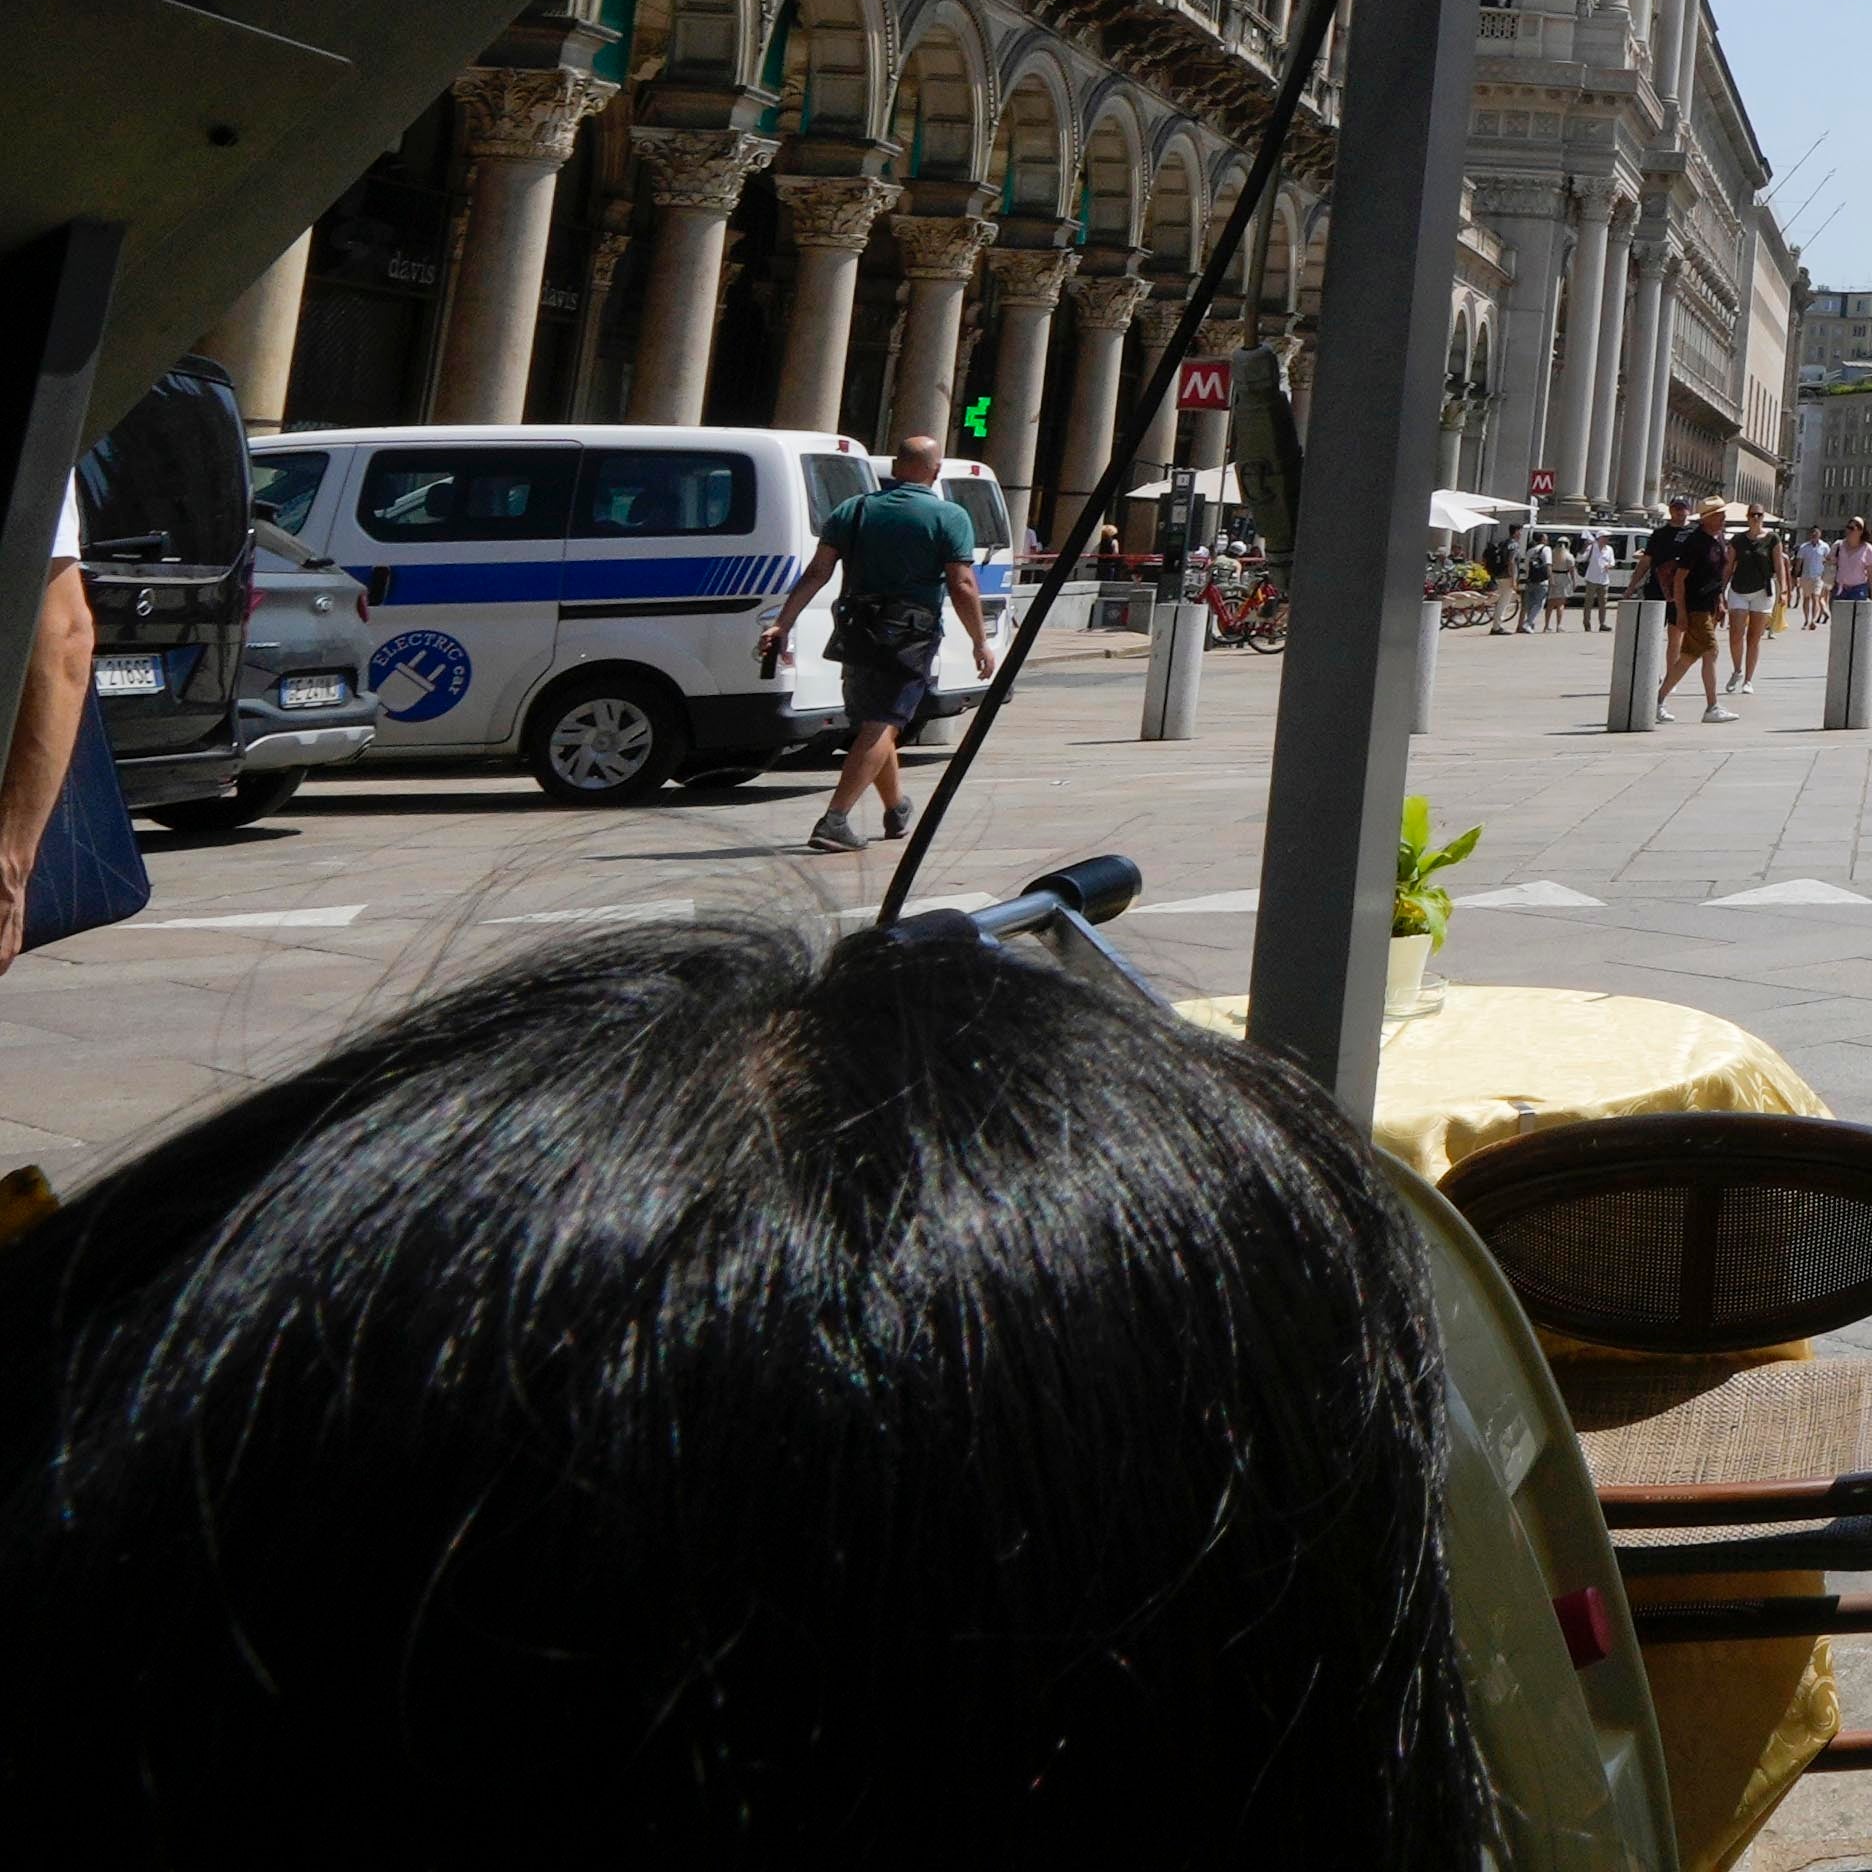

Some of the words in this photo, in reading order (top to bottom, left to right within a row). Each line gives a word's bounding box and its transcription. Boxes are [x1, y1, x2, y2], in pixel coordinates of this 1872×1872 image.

[387, 248, 436, 285] davis
[1182, 371, 1225, 400] M
[1531, 474, 1553, 490] M
[372, 633, 464, 666] ELECTRIC
[448, 665, 465, 695] car
